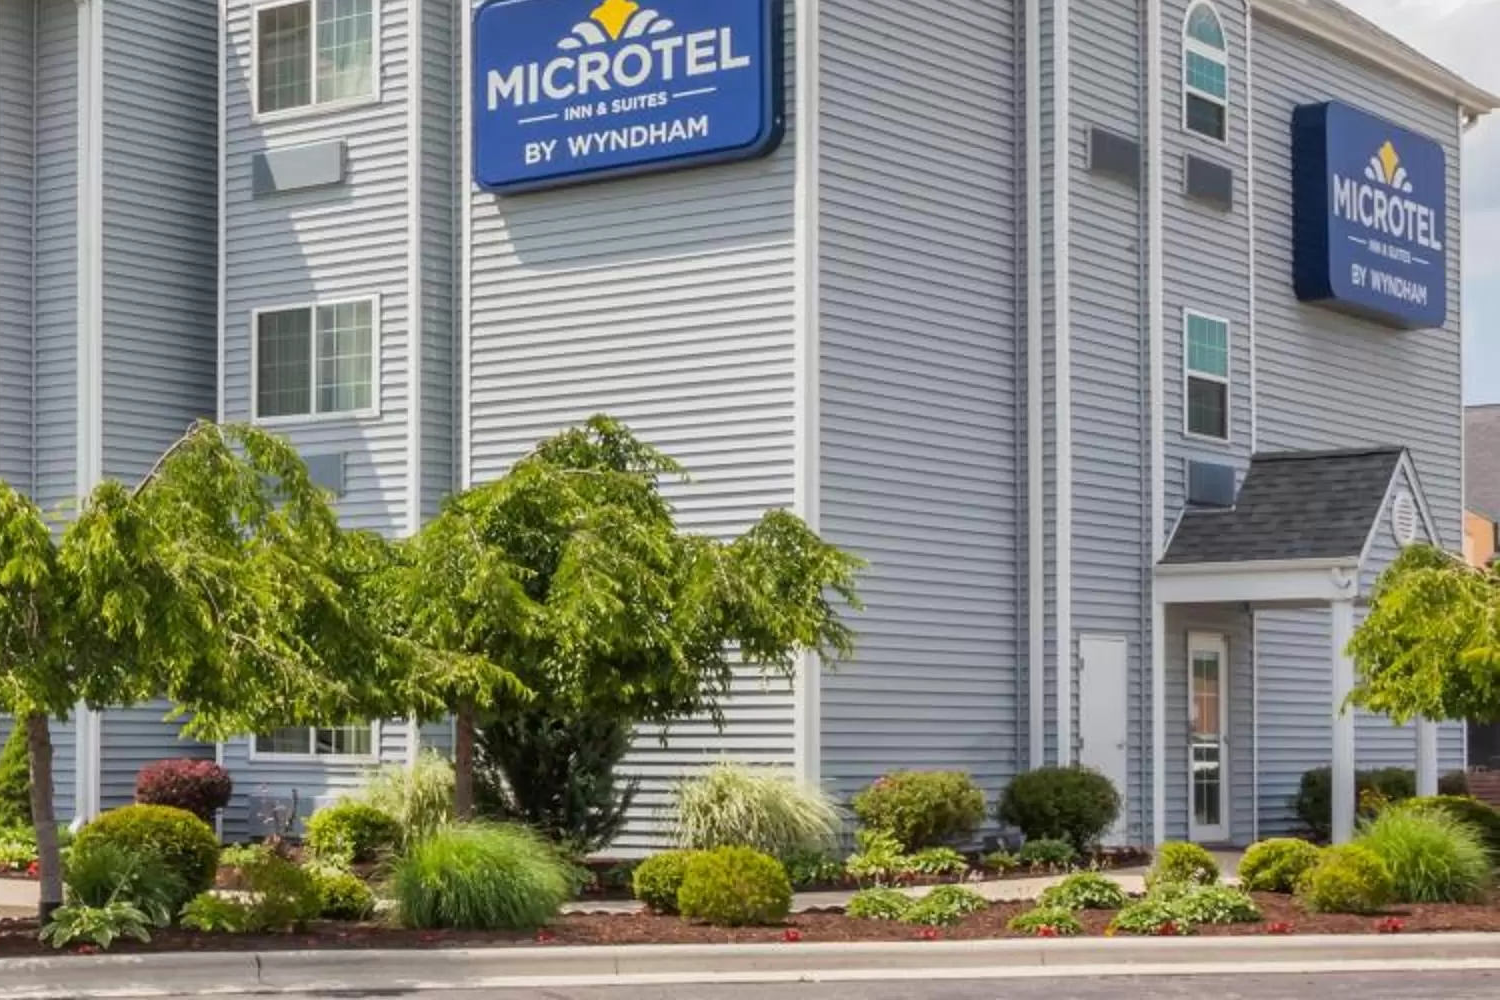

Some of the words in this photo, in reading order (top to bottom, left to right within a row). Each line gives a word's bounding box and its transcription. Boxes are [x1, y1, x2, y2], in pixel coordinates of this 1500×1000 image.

[487, 27, 750, 111] MICROTEL
[564, 104, 592, 120] INN
[596, 102, 607, 116] &
[612, 92, 667, 113] SUITES
[525, 139, 557, 165] BY
[568, 115, 709, 157] WYNDHAM
[1332, 174, 1442, 251] MICROTEL
[1352, 264, 1367, 287] BY
[1370, 269, 1427, 306] WYNDHAM
